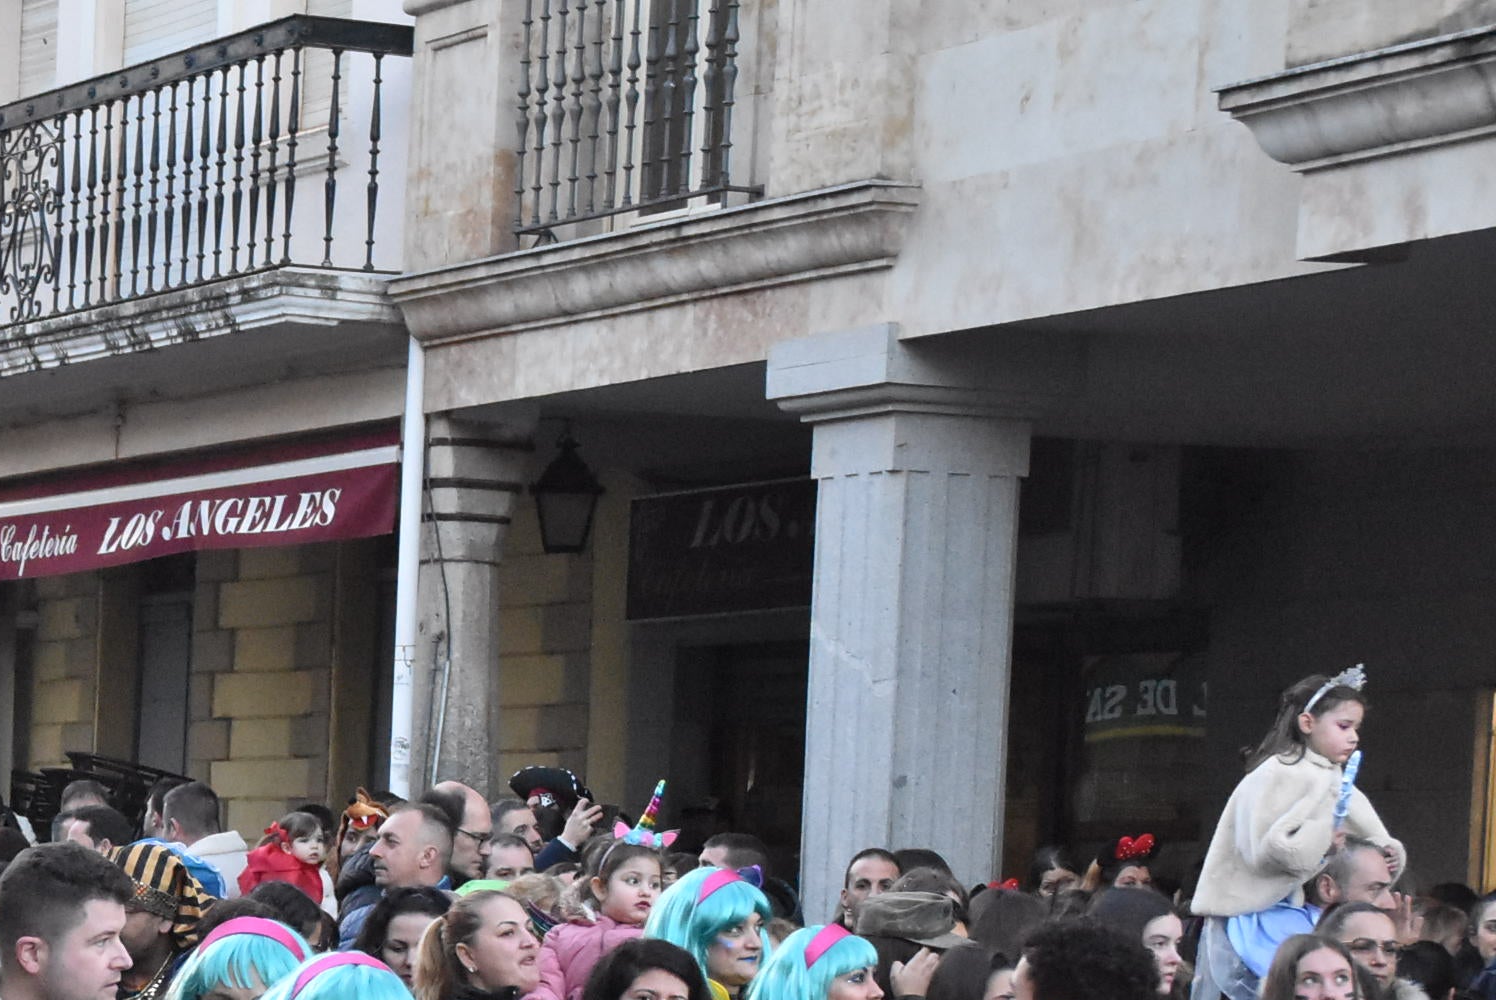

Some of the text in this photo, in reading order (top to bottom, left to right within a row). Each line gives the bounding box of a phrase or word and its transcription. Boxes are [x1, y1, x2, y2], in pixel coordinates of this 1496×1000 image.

[0, 487, 342, 577] Cafetería LOS ANGELES
